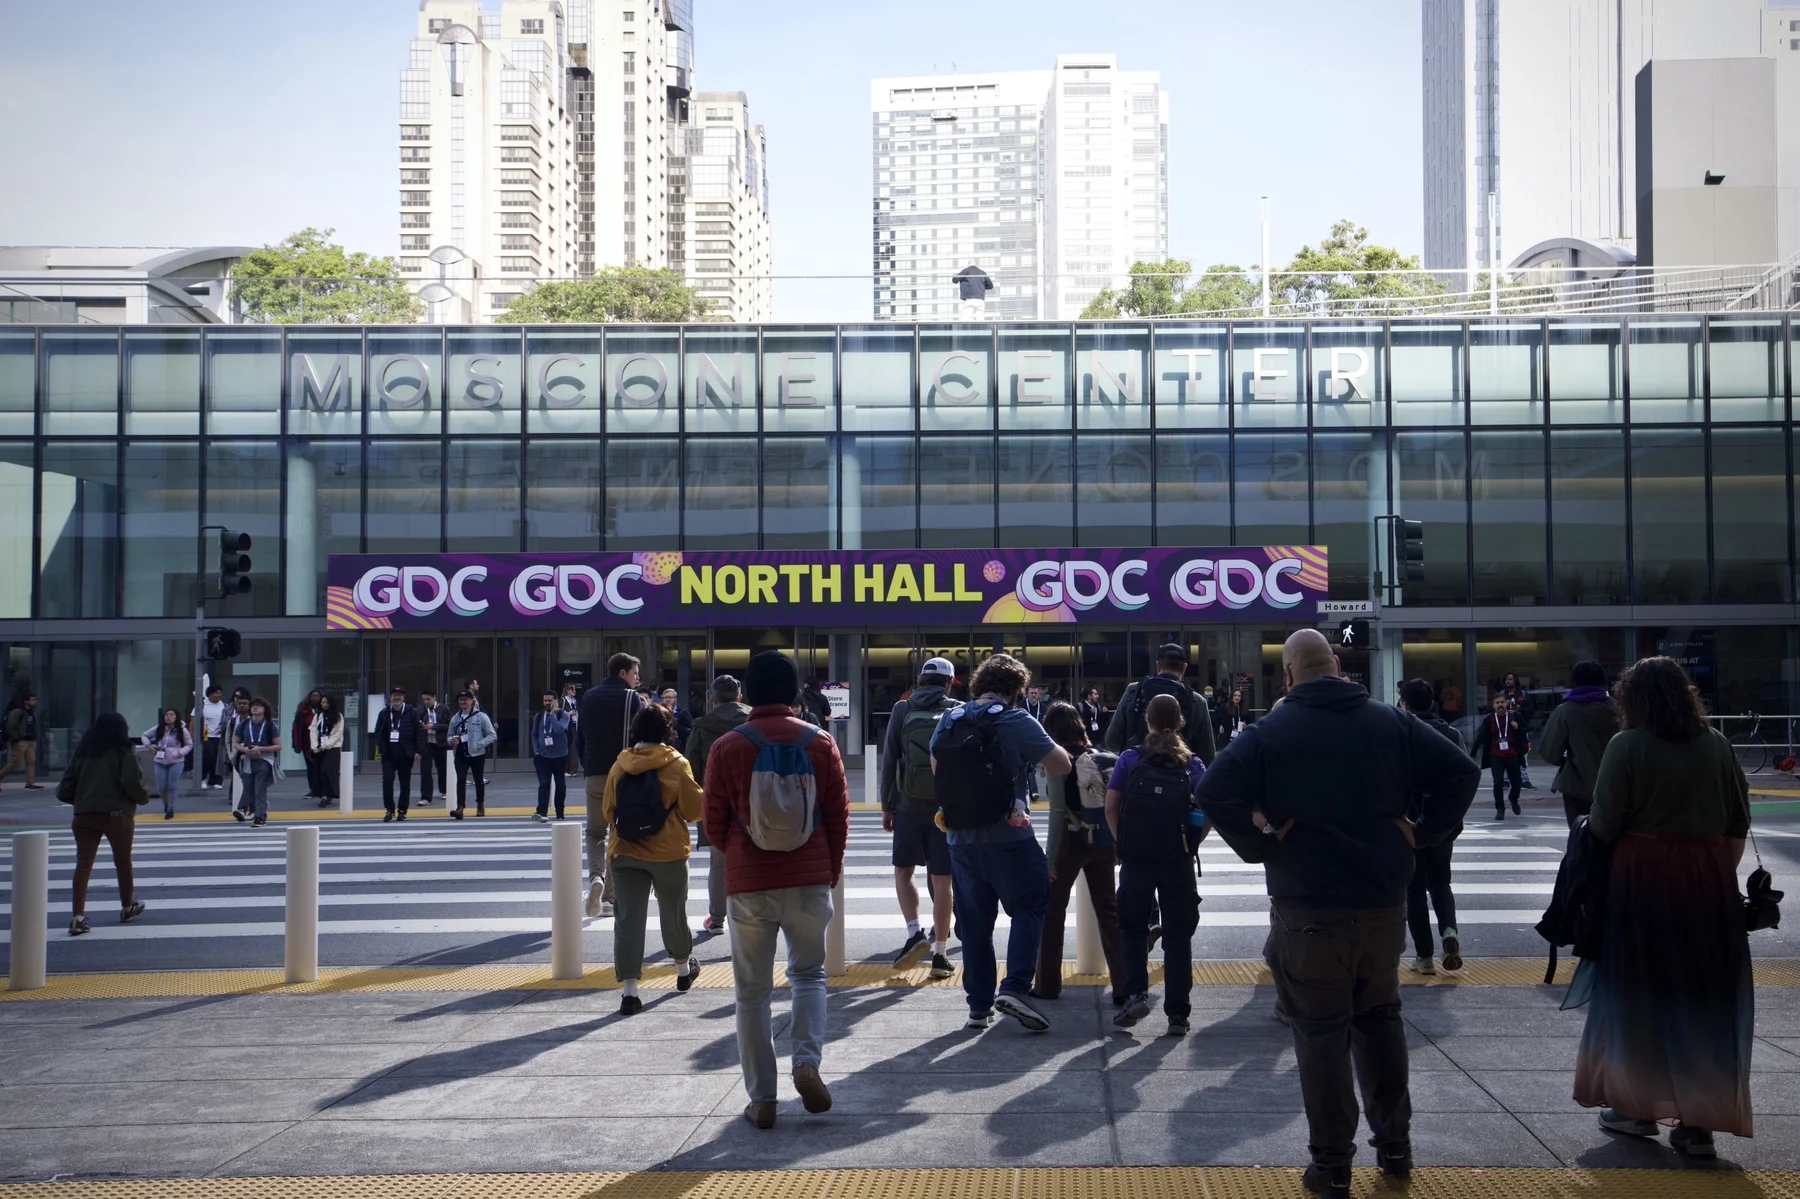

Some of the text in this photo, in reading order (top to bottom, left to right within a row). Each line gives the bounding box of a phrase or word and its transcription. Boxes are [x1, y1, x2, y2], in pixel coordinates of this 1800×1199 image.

[290, 346, 1373, 410] MOSCONE CENTER
[352, 557, 1304, 617] GDC GDC NORTH HALL GDC GDC
[1324, 603, 1367, 611] Howard
